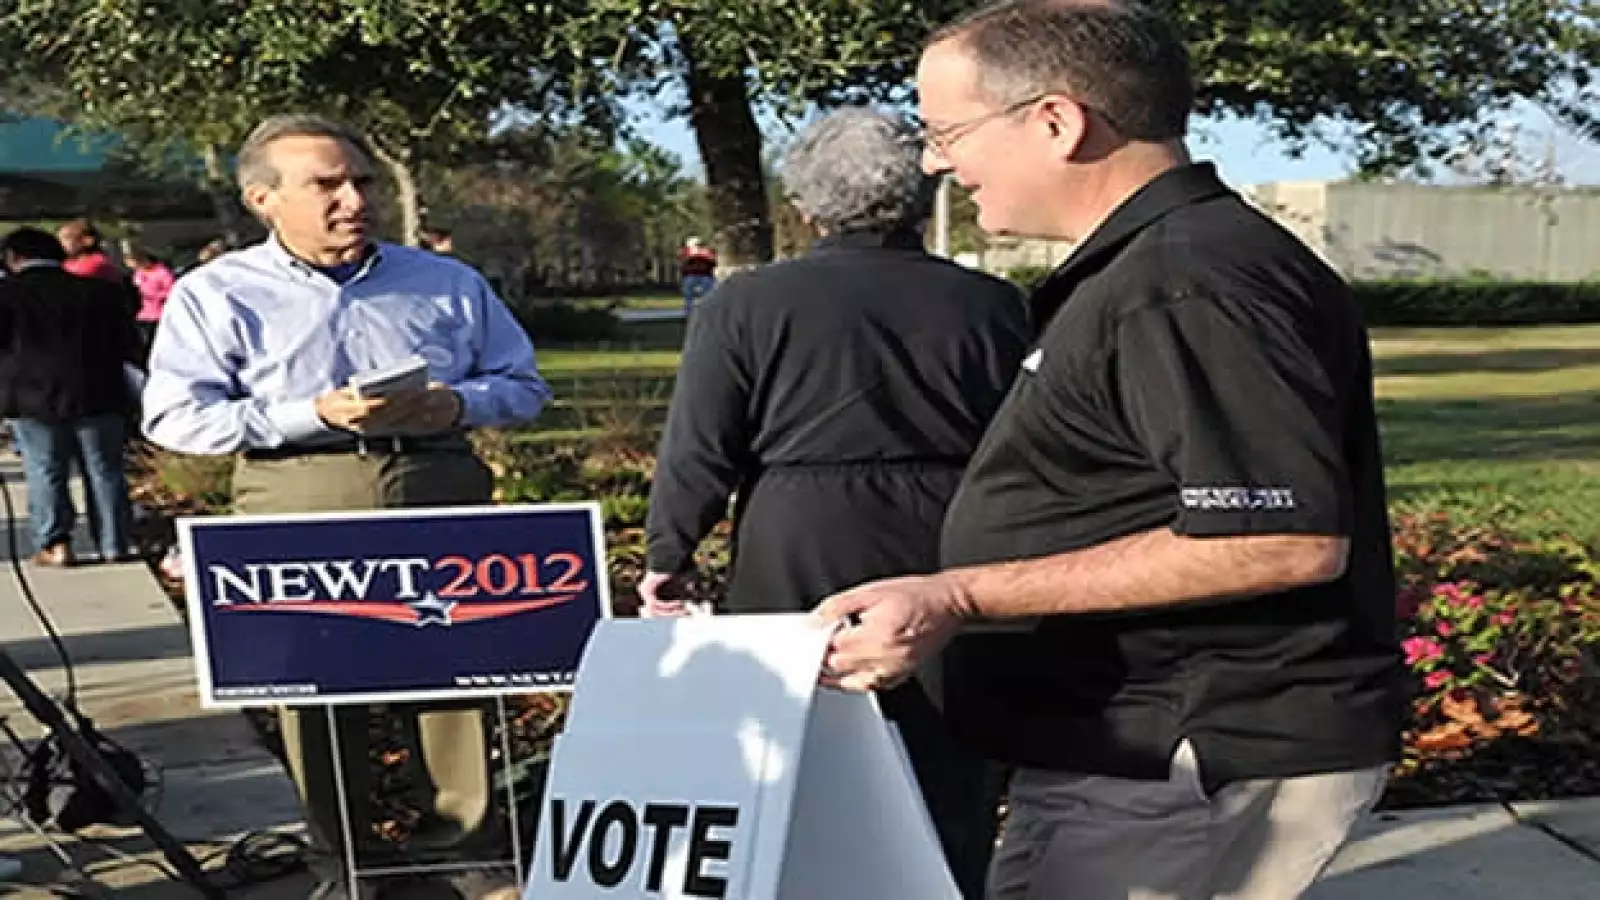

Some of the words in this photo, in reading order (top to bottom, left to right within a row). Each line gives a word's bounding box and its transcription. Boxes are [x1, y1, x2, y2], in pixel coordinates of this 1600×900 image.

[208, 558, 430, 606] NEWT
[432, 552, 588, 598] 2012
[550, 799, 739, 897] VOTE
